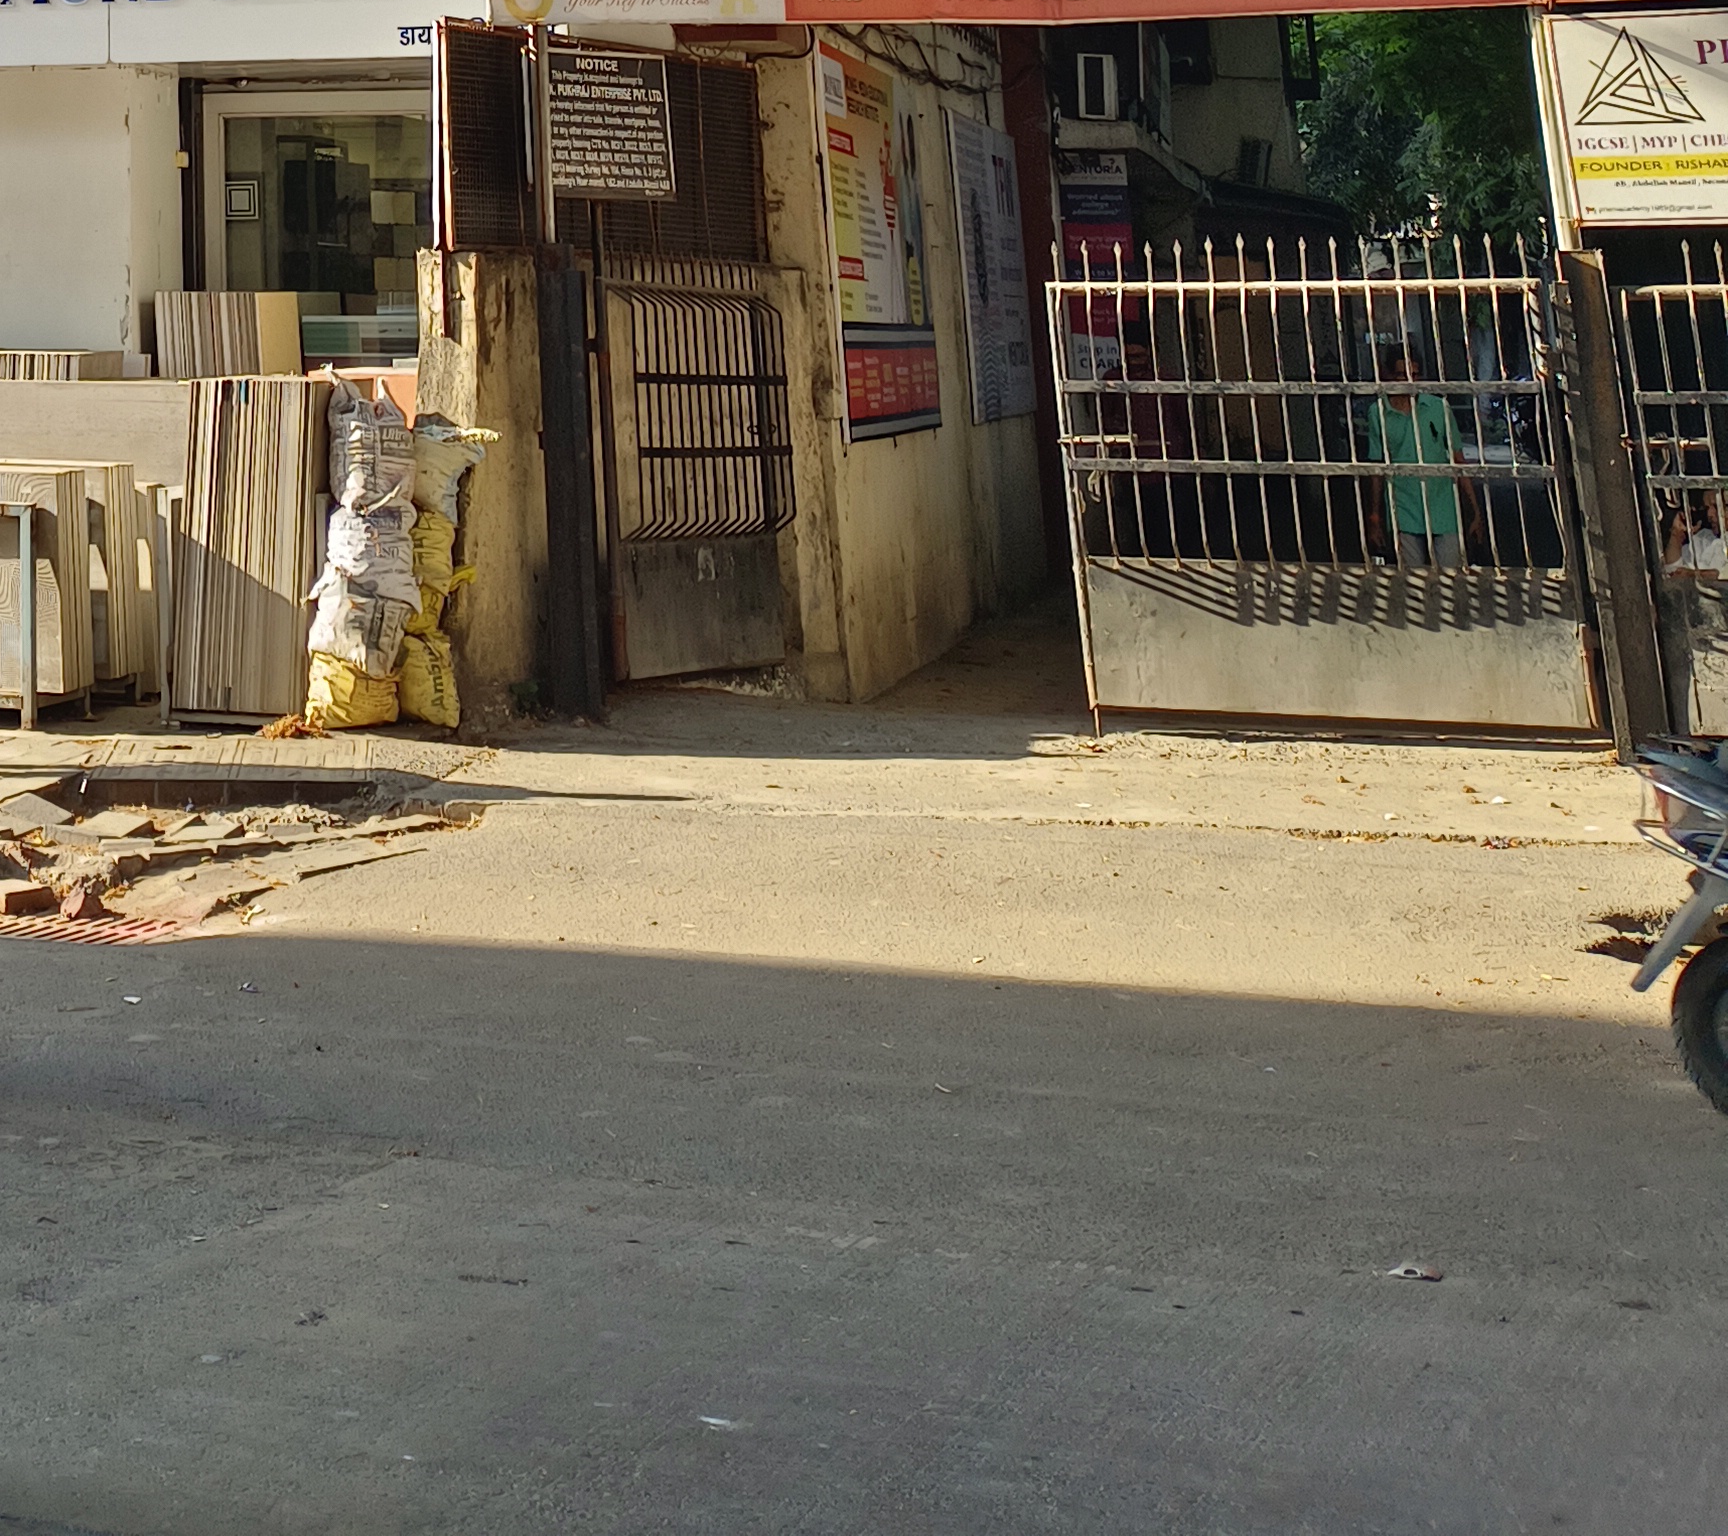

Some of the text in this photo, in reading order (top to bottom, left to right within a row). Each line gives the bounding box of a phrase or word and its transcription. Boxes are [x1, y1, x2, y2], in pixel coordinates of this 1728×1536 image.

[576, 57, 619, 72] NOTICE
[1577, 134, 1678, 150] IGCSE MYP
[1580, 160, 1663, 173] FOUNDER
